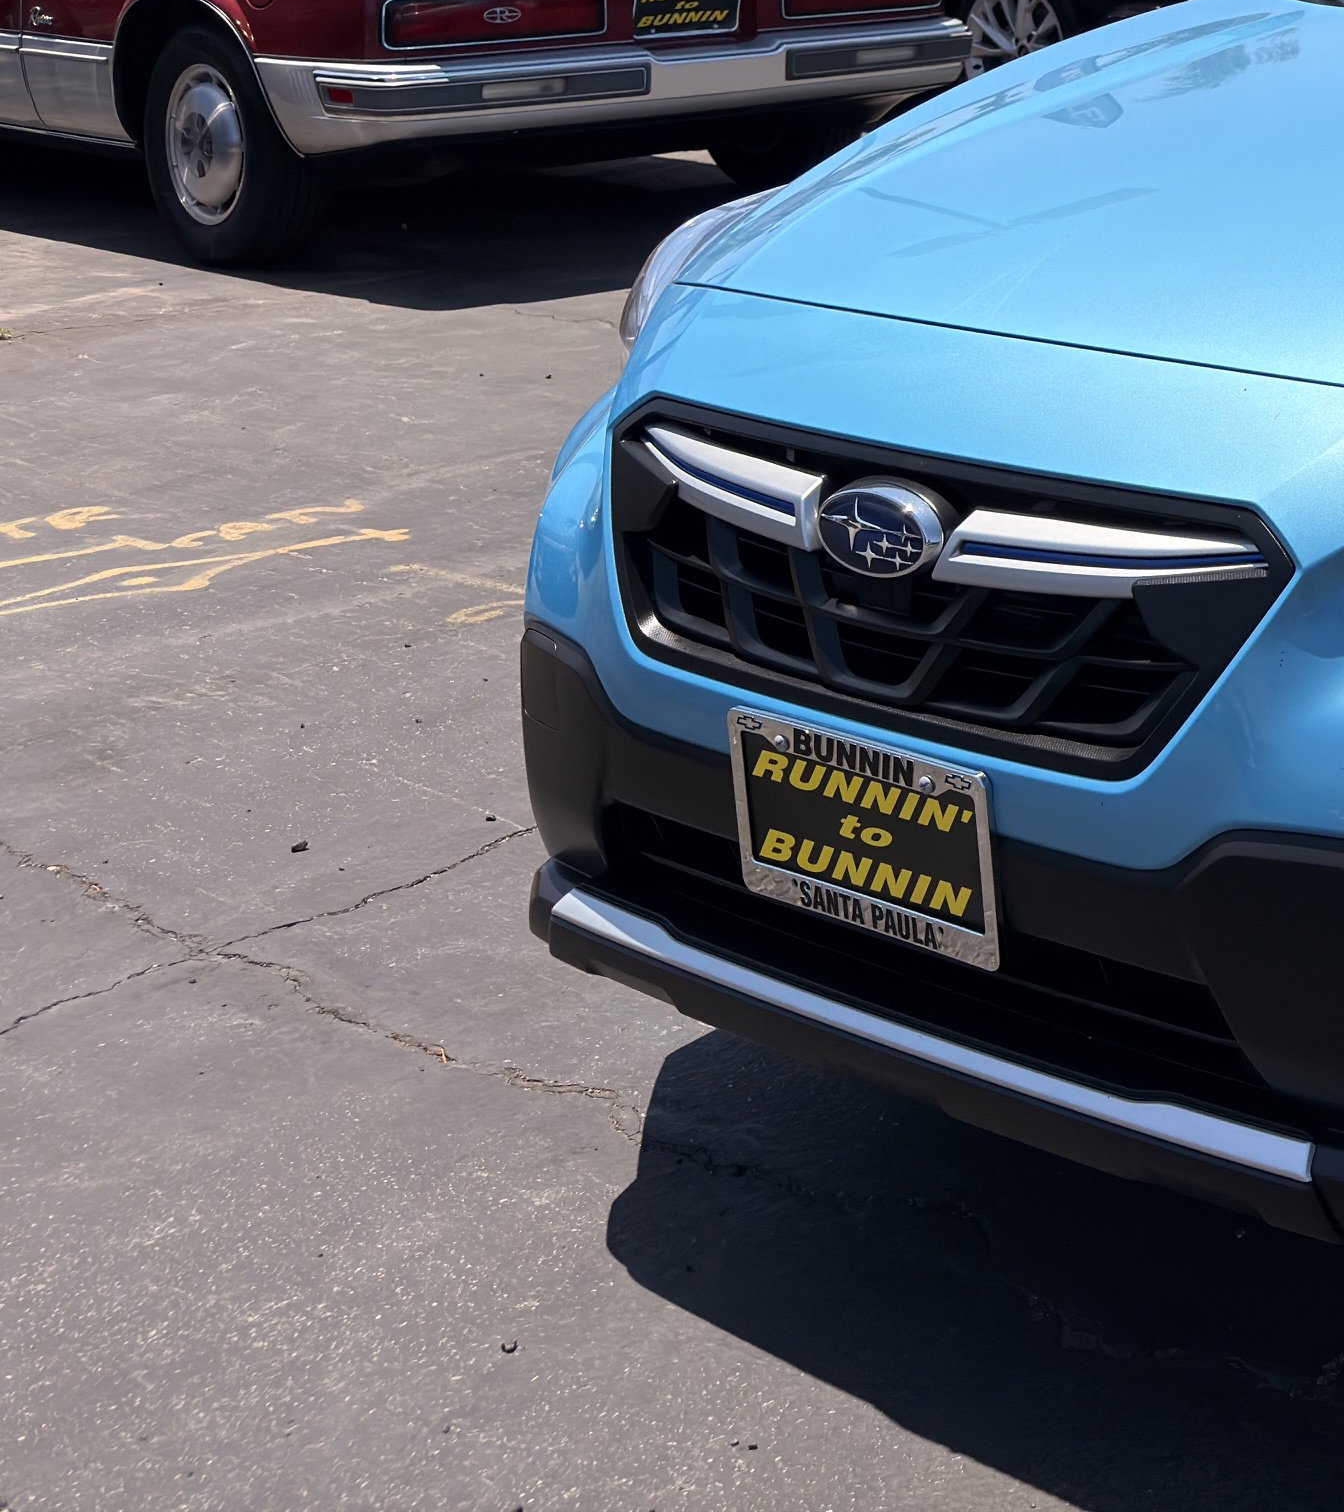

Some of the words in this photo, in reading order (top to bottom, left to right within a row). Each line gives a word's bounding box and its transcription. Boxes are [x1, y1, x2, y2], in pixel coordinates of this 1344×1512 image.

[636, 10, 730, 28] BUNNIN
[673, 0, 700, 10] to
[793, 728, 915, 788] BUNNIN
[752, 750, 973, 832] RUNNIN'
[838, 814, 893, 848] to
[759, 828, 973, 917] BUNNIN
